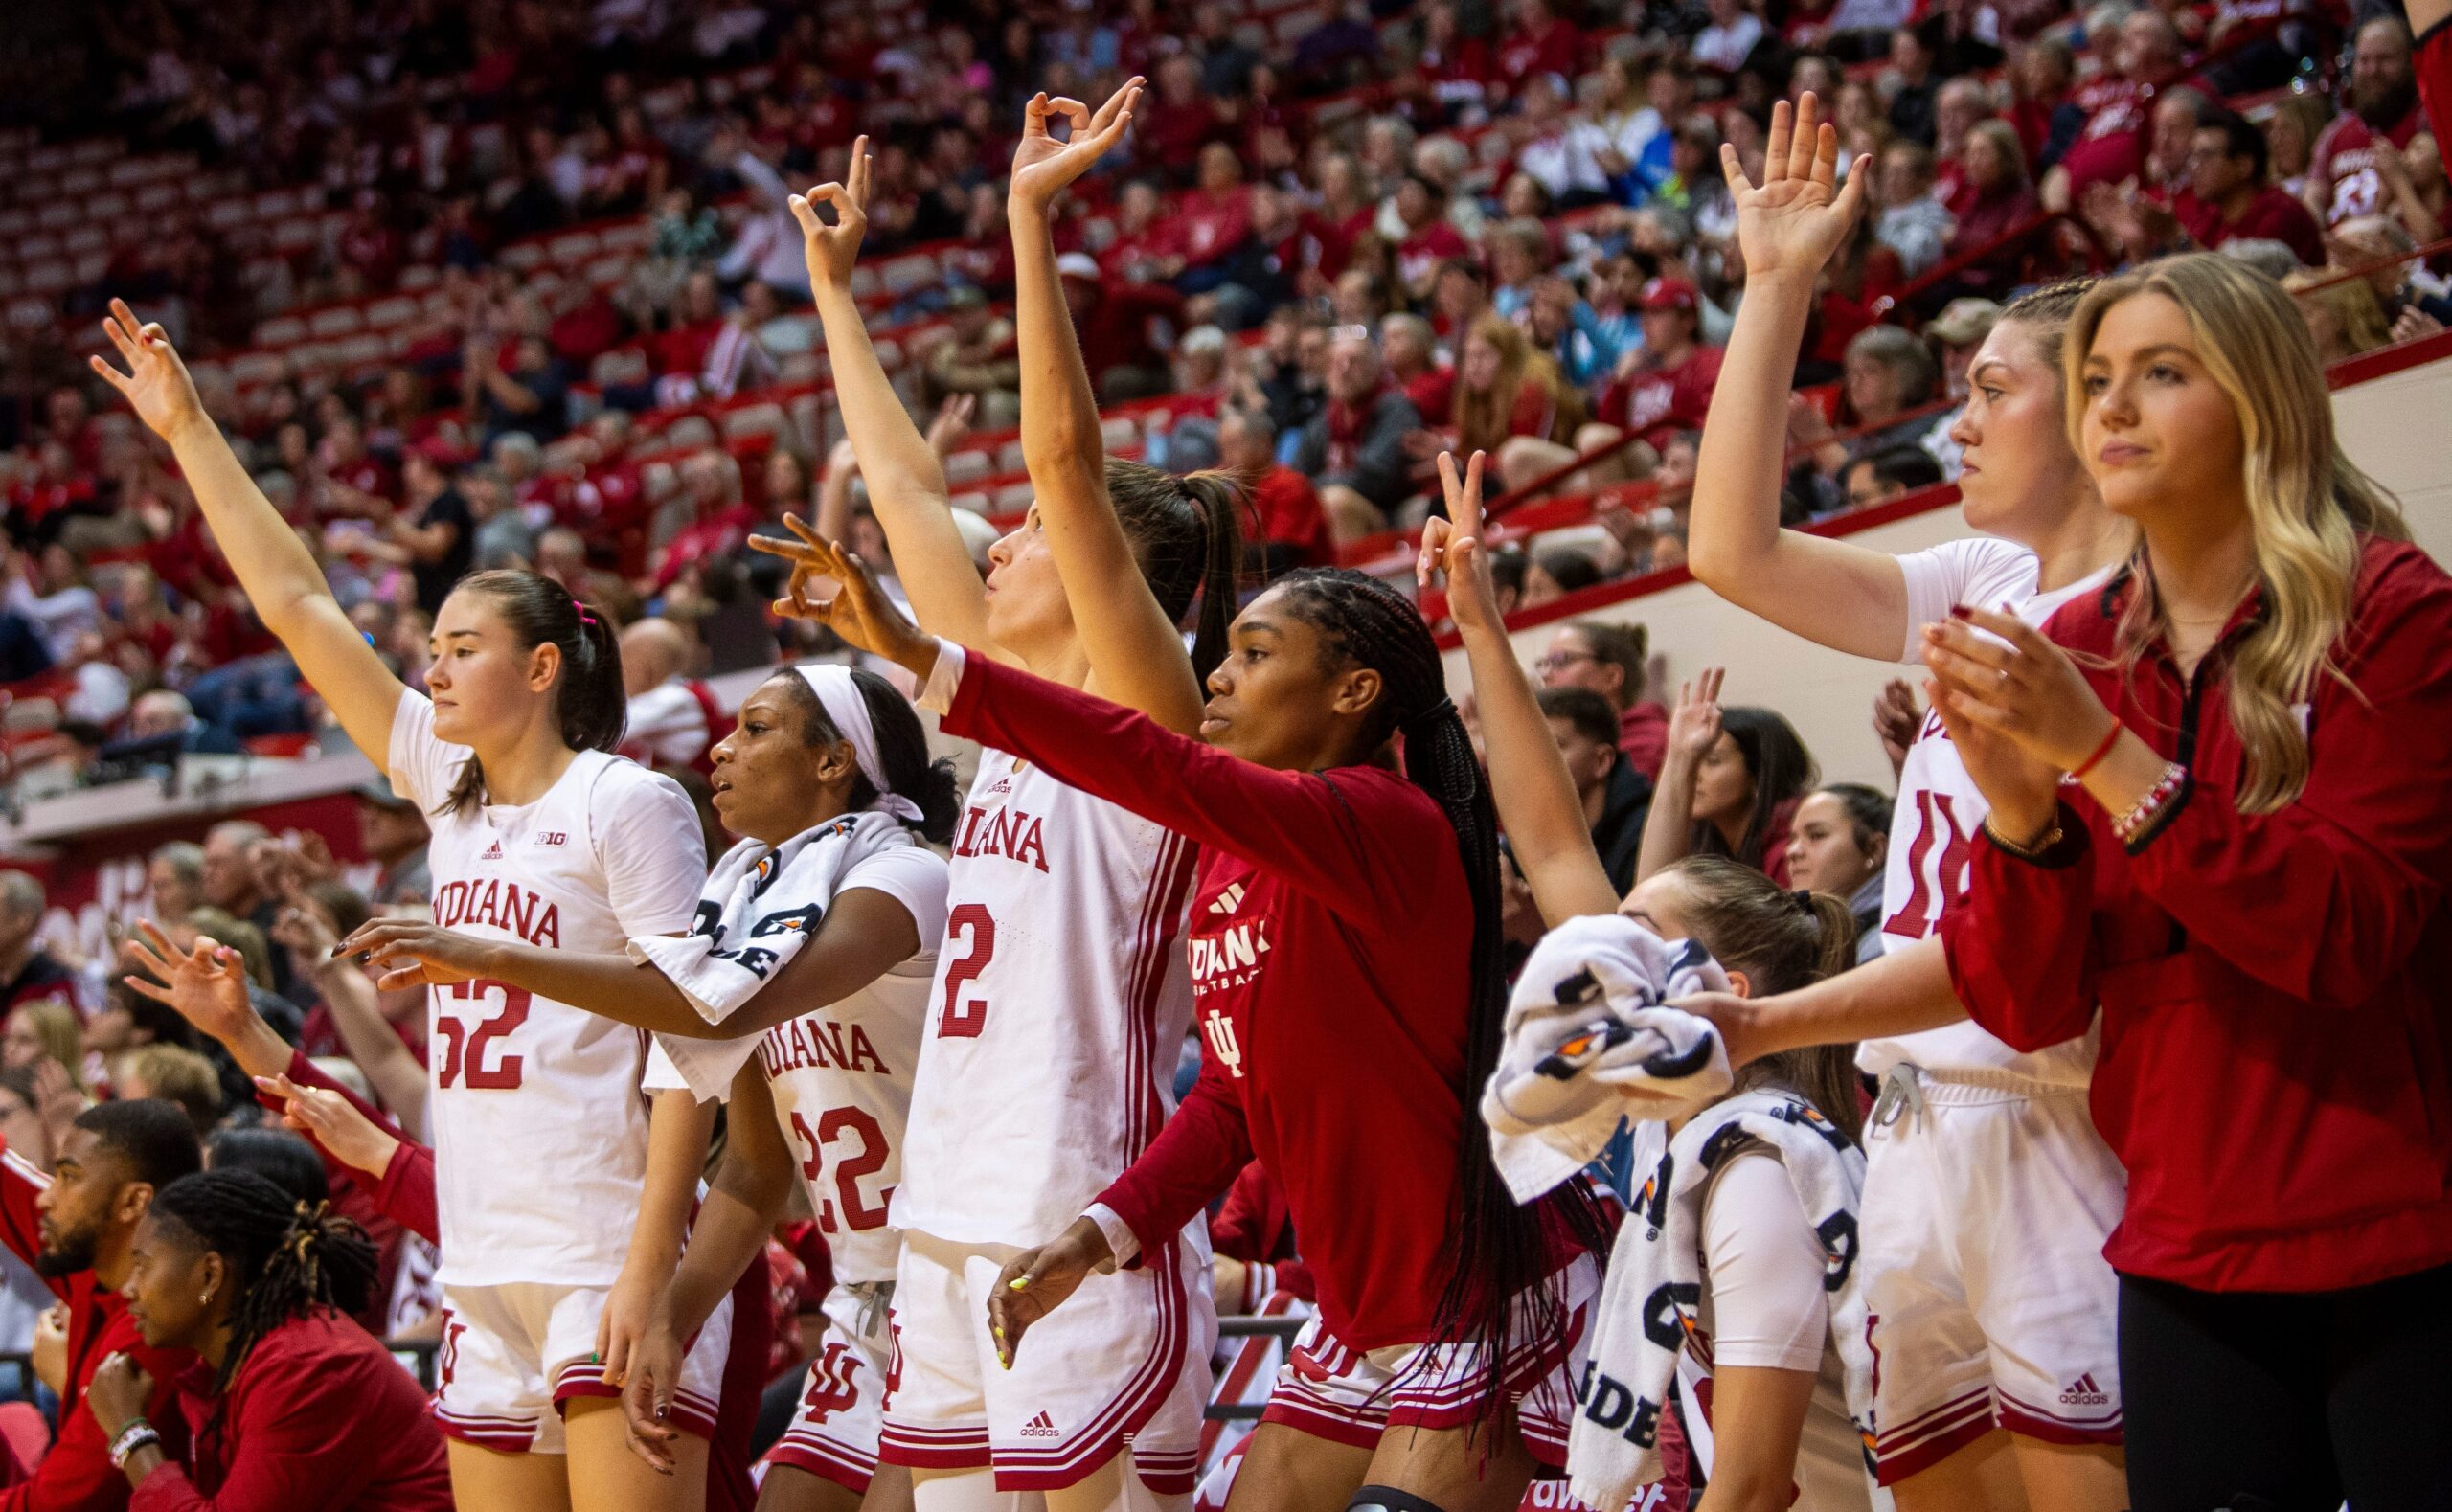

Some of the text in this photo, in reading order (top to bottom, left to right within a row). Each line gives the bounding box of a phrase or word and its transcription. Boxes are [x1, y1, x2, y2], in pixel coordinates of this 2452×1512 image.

[938, 903, 996, 1039] 2
[434, 979, 533, 1090] 52
[2059, 1392, 2109, 1405] adidas
[1020, 1427, 1059, 1437] adidas
